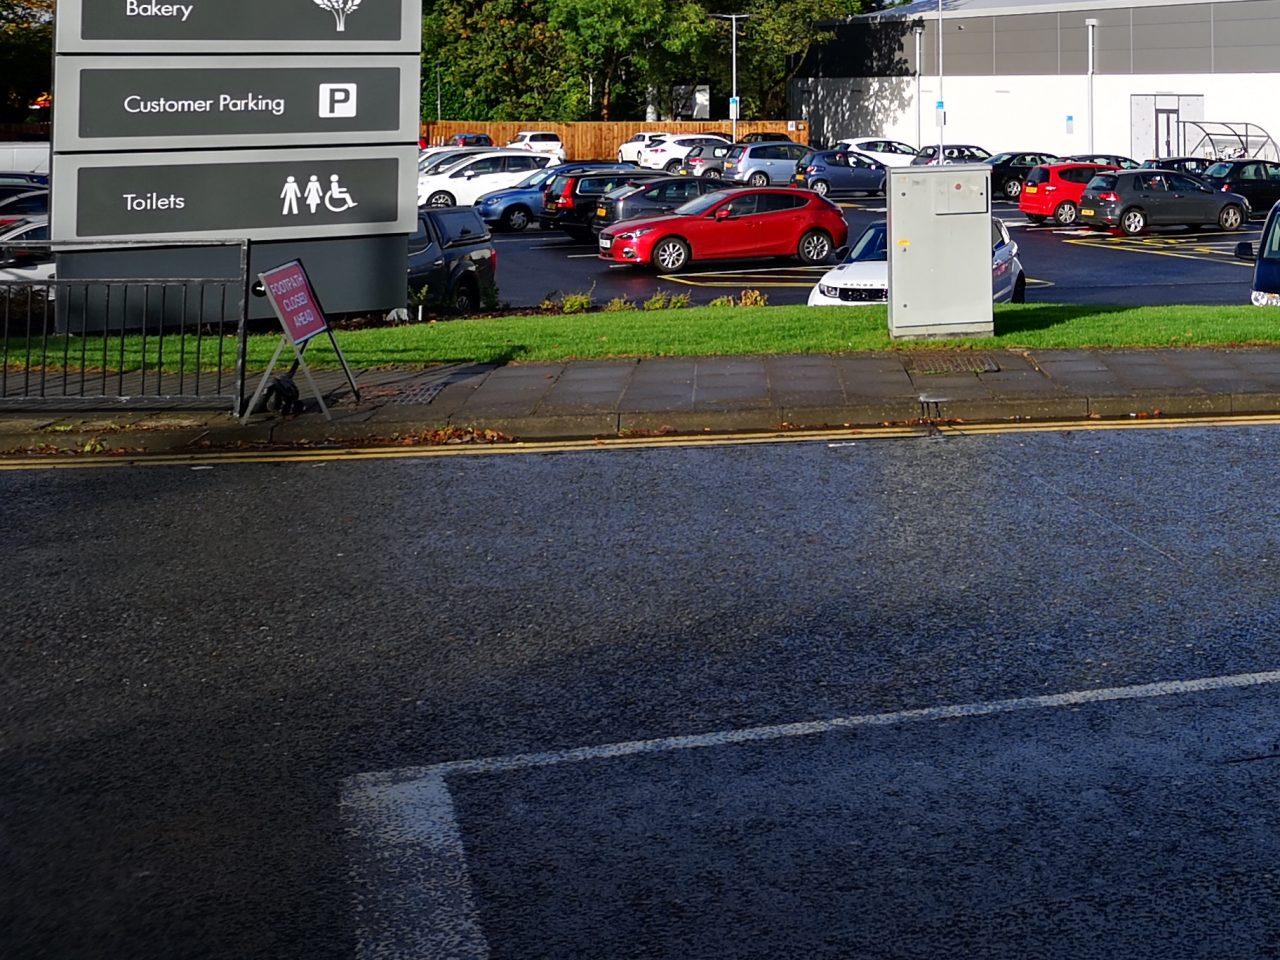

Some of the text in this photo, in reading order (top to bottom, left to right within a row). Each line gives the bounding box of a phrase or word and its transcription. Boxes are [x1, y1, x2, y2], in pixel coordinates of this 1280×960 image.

[124, 93, 285, 115] Customer Parking
[329, 88, 351, 114] P
[123, 193, 185, 211] Toilets
[270, 273, 305, 296] FOOTPATH
[282, 292, 308, 311] CLOSED
[293, 309, 314, 328] AHEAD
